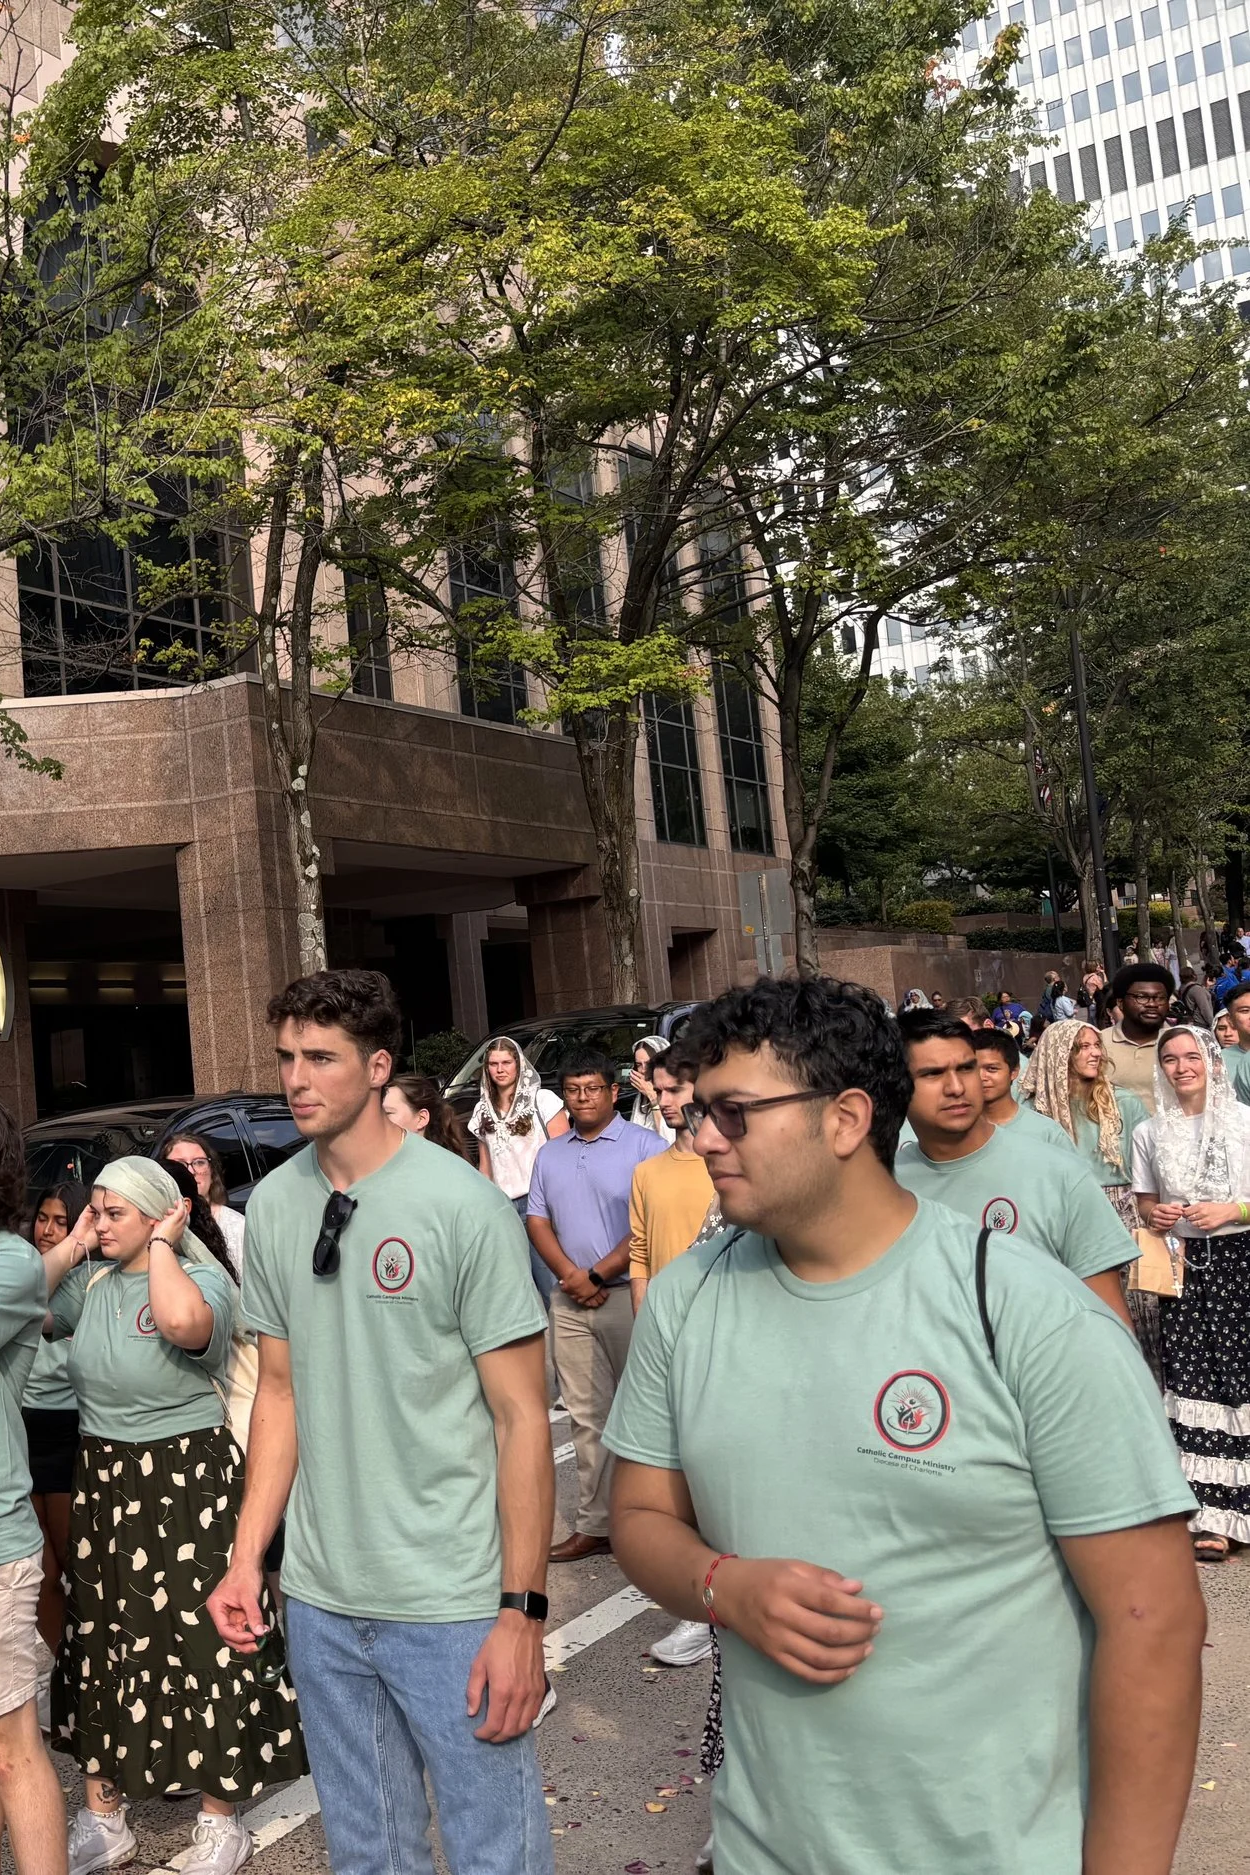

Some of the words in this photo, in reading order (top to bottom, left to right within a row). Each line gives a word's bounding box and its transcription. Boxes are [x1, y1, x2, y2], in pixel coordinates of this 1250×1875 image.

[856, 1446, 887, 1458] Catholic
[888, 1452, 921, 1465] Campus
[922, 1459, 957, 1473] Ministry
[873, 1457, 899, 1467] Diocese
[909, 1464, 943, 1477] Charlotte
